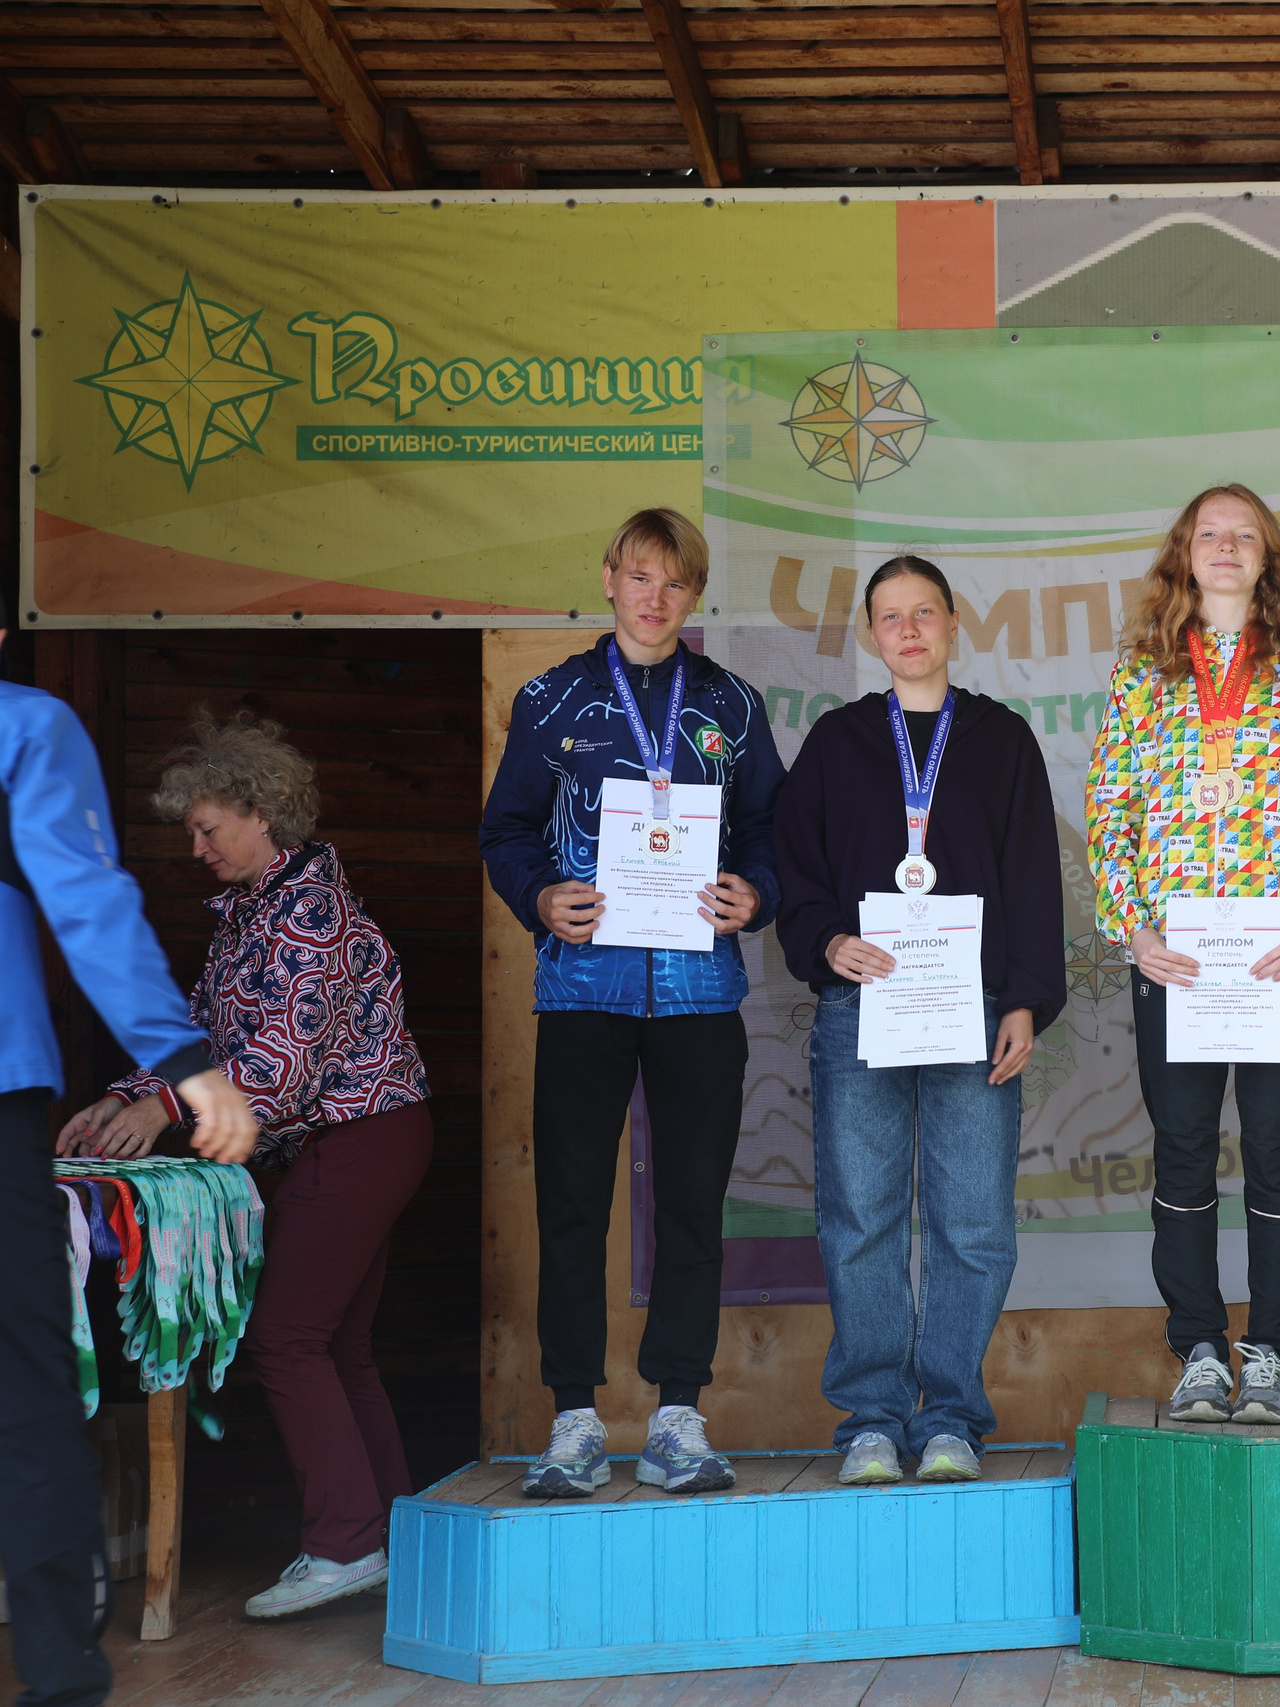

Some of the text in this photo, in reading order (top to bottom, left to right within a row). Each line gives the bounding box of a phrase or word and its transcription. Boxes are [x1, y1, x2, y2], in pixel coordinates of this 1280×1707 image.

[311, 431, 655, 453] СПОРТИВНО-ТУРИСТИЧЕСКИЙ
[892, 938, 949, 950] ДИПЛОМ
[1197, 938, 1254, 948] ДИПЛОМ
